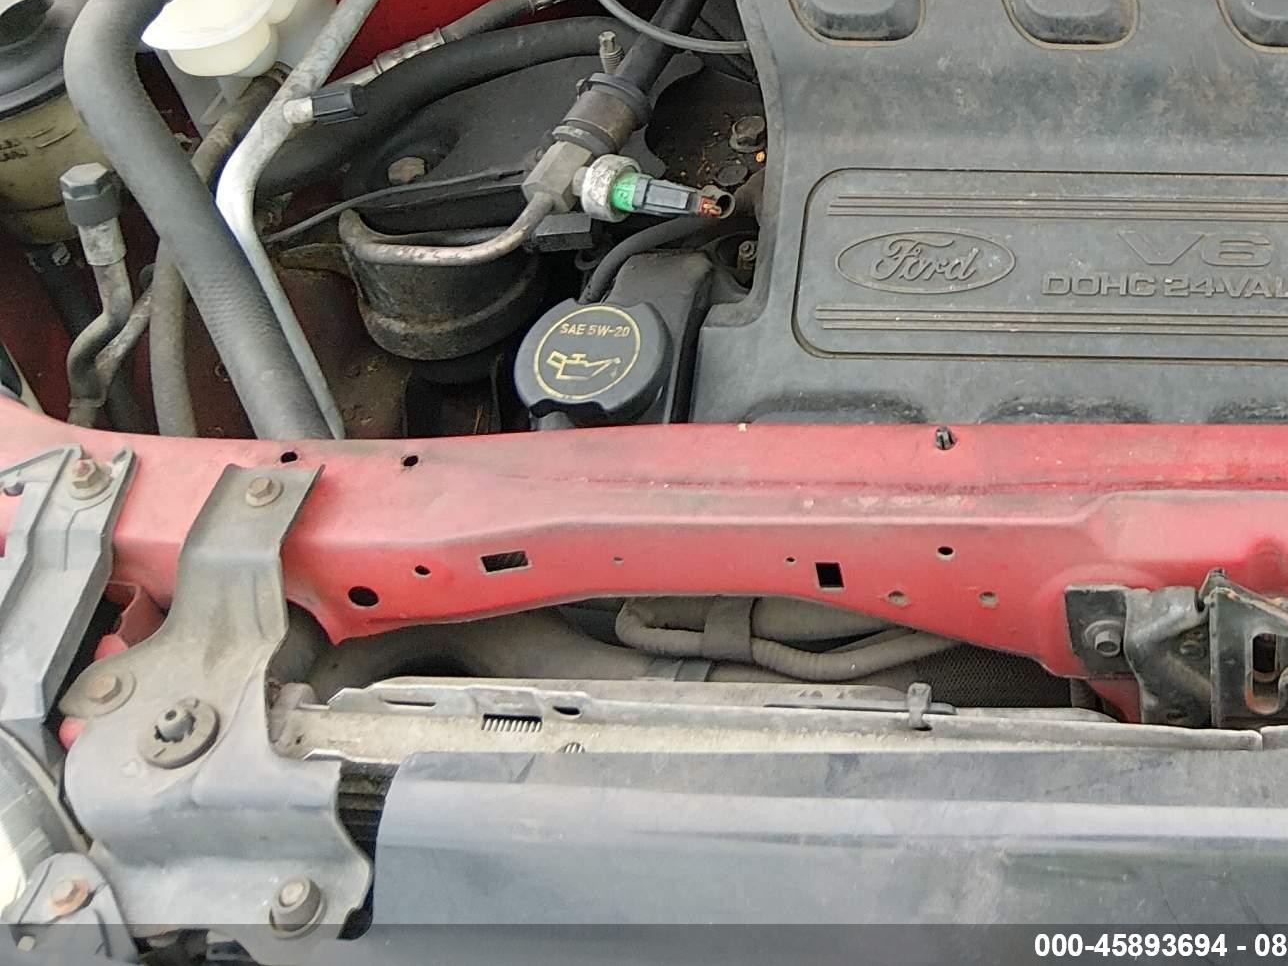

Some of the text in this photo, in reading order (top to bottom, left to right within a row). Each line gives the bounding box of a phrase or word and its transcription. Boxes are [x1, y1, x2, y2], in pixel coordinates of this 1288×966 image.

[872, 237, 980, 282] Ford
[1116, 231, 1272, 267] V6
[1041, 272, 1155, 296] DOHC
[559, 323, 631, 338] SAE 5W-20
